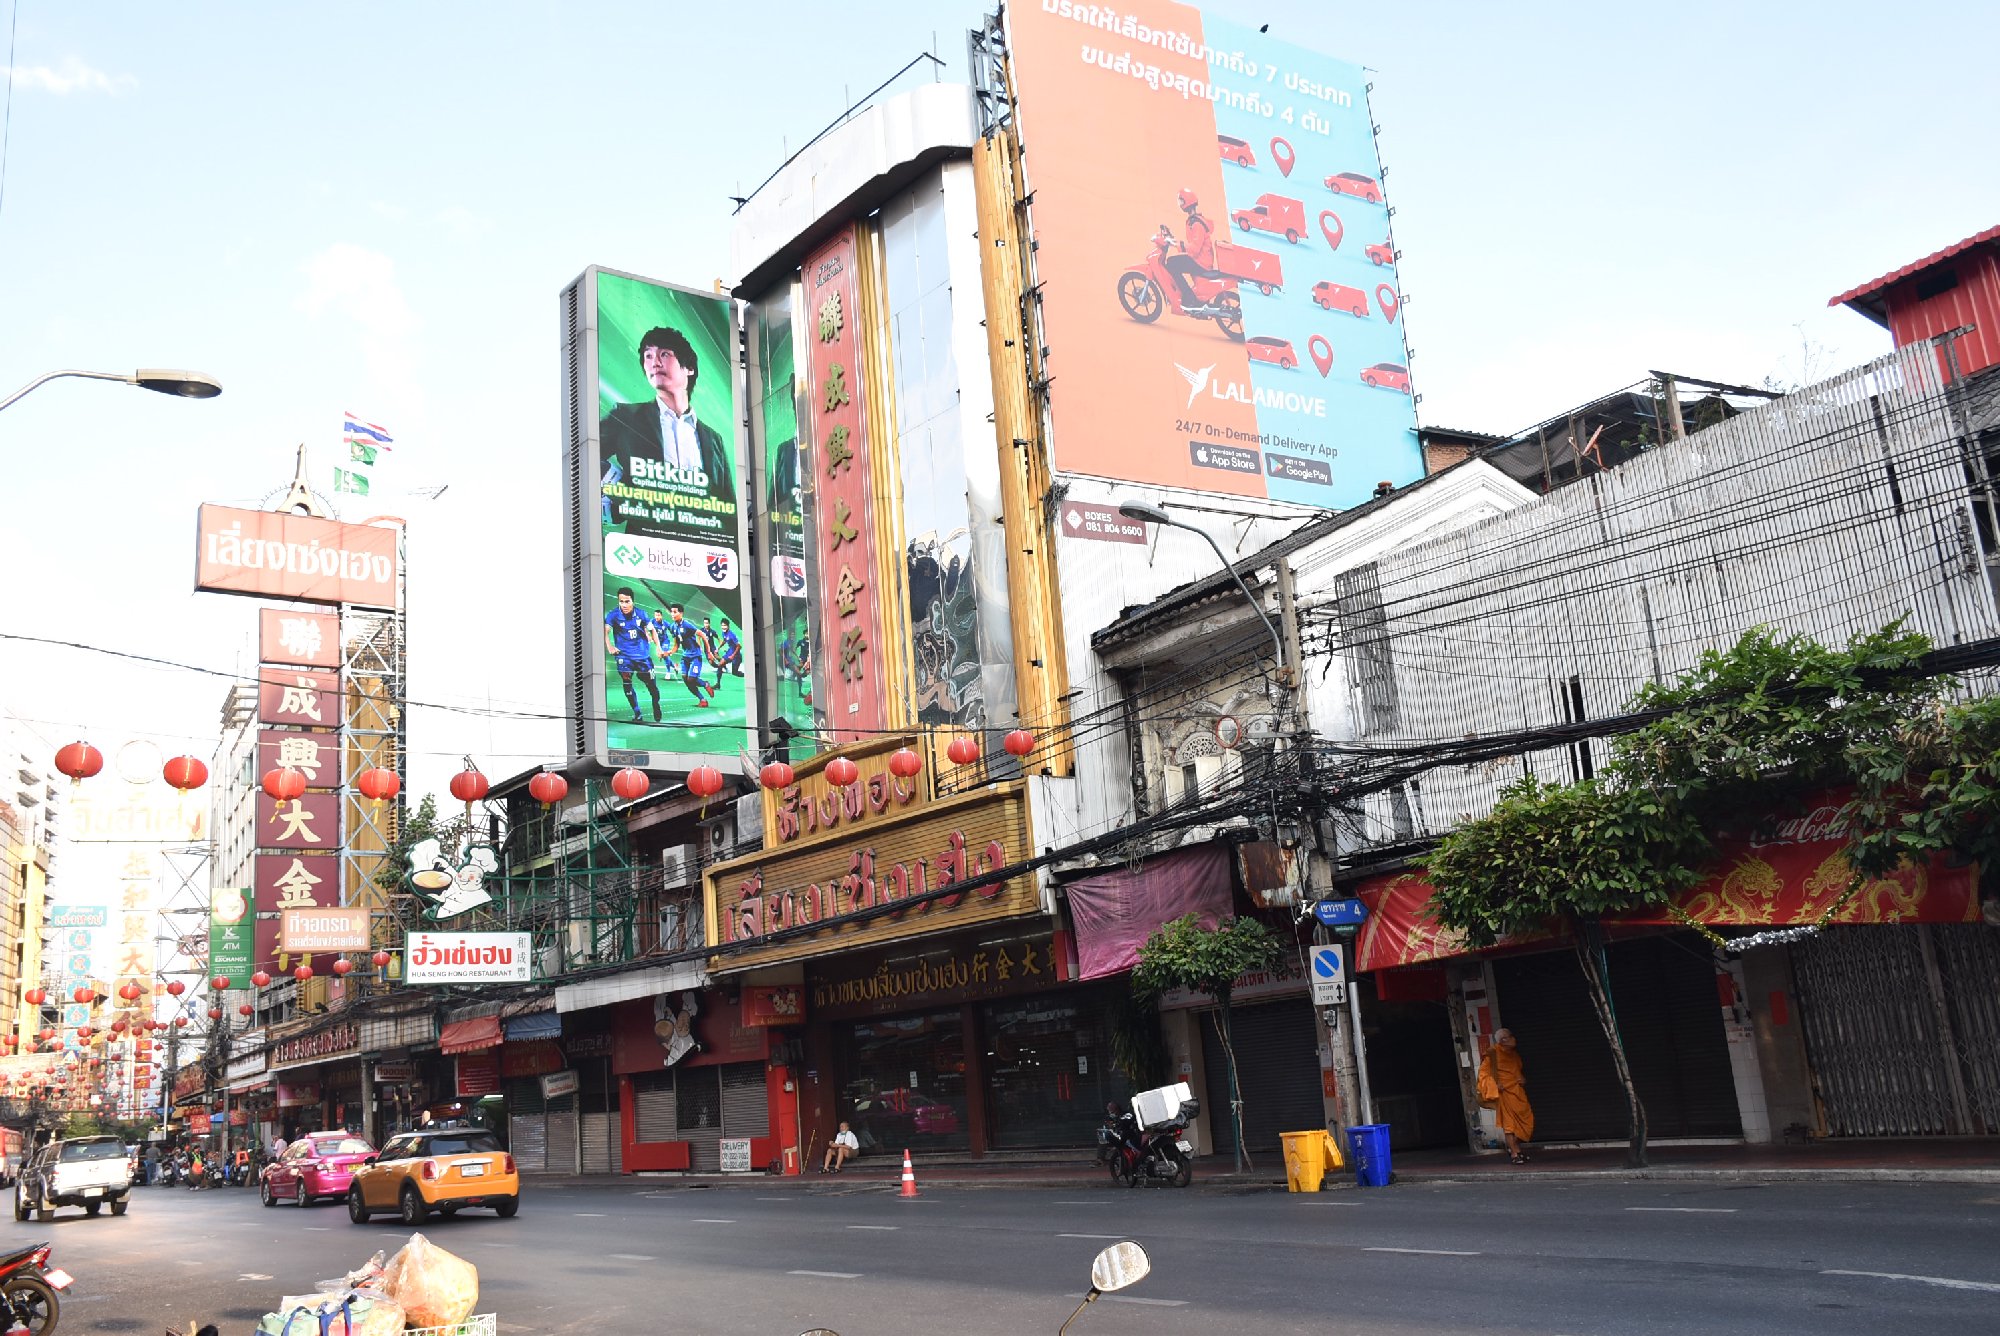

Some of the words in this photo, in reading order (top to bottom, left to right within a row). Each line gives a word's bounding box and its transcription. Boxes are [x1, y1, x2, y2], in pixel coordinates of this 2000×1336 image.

[1081, 45, 1274, 118] ขนส่งสูงสุดมากถึง
[1280, 107, 1295, 127] 4
[1301, 107, 1331, 136] ตัน
[1264, 65, 1278, 83] 7
[1284, 70, 1353, 109] ประเภท
[1212, 379, 1327, 418] LALAMOVE
[1175, 419, 1202, 434] 24/7
[1205, 424, 1270, 446] On-Demand
[1273, 435, 1316, 455] Delivery
[1318, 443, 1338, 460] App
[629, 456, 709, 488] Bitkub
[1211, 455, 1231, 468] App
[1231, 458, 1256, 470] Store
[1286, 463, 1312, 480] Google
[1312, 468, 1328, 483] Play
[632, 477, 657, 488] Capital
[657, 482, 678, 492] Group
[678, 485, 707, 496] Holdings
[602, 480, 736, 515] สนับสนุนฟุตบอลไทย
[1084, 511, 1112, 522] BOXES
[648, 547, 693, 568] bitkub
[1354, 903, 1361, 916] 4
[289, 911, 350, 933] ที่จอดรถ
[222, 942, 240, 951] ATM
[214, 955, 248, 963] EXCHANGE
[468, 969, 512, 977] RESTAURANT
[721, 1141, 749, 1150] DELIVERY
